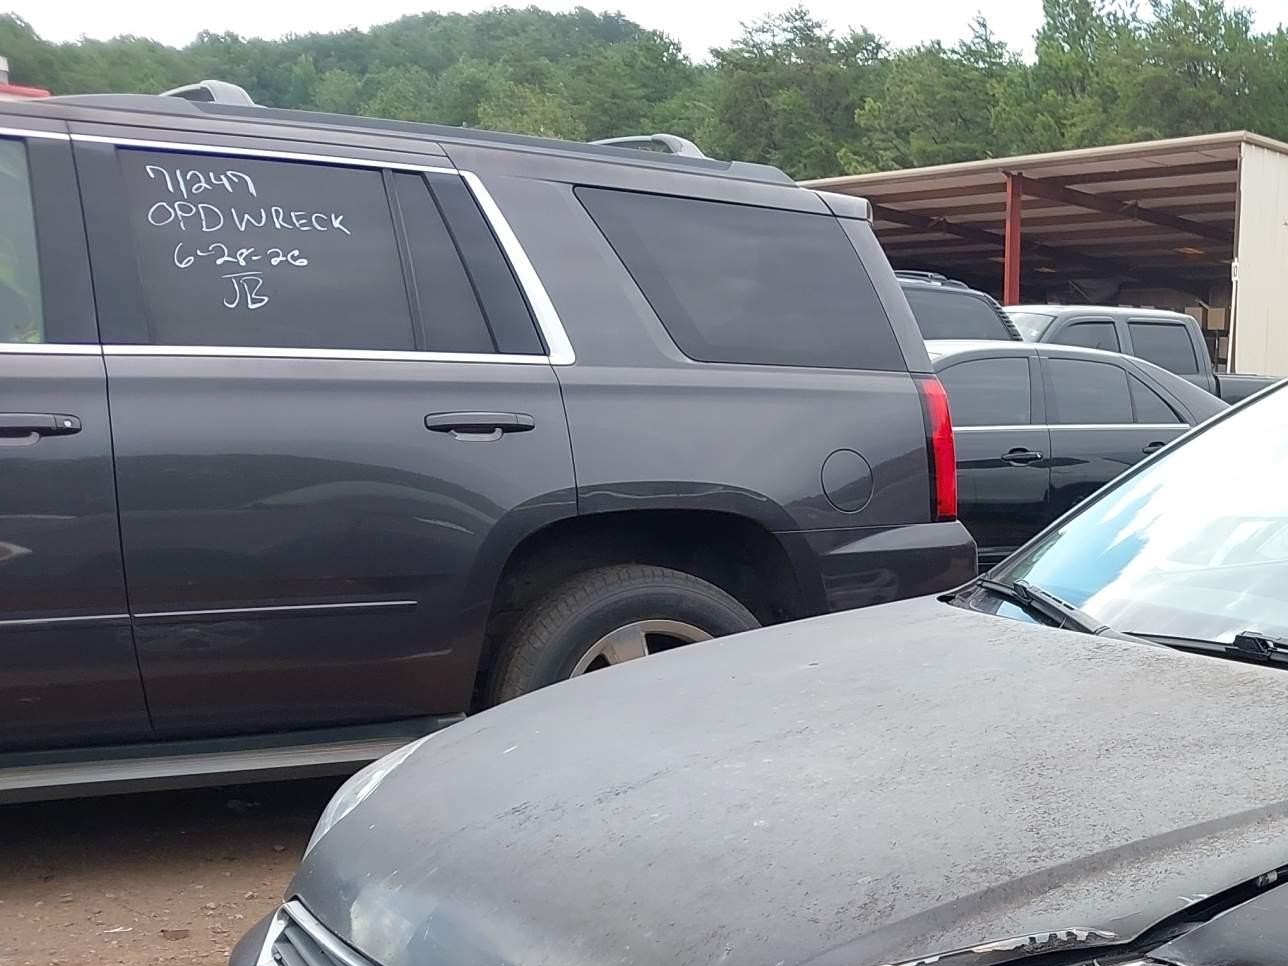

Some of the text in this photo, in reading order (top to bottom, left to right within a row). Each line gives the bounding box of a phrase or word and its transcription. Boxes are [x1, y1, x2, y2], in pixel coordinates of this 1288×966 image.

[144, 164, 258, 199] 71247
[147, 200, 352, 236] OPD WRECK
[173, 242, 309, 269] 6-28-26
[222, 274, 271, 310] JB
